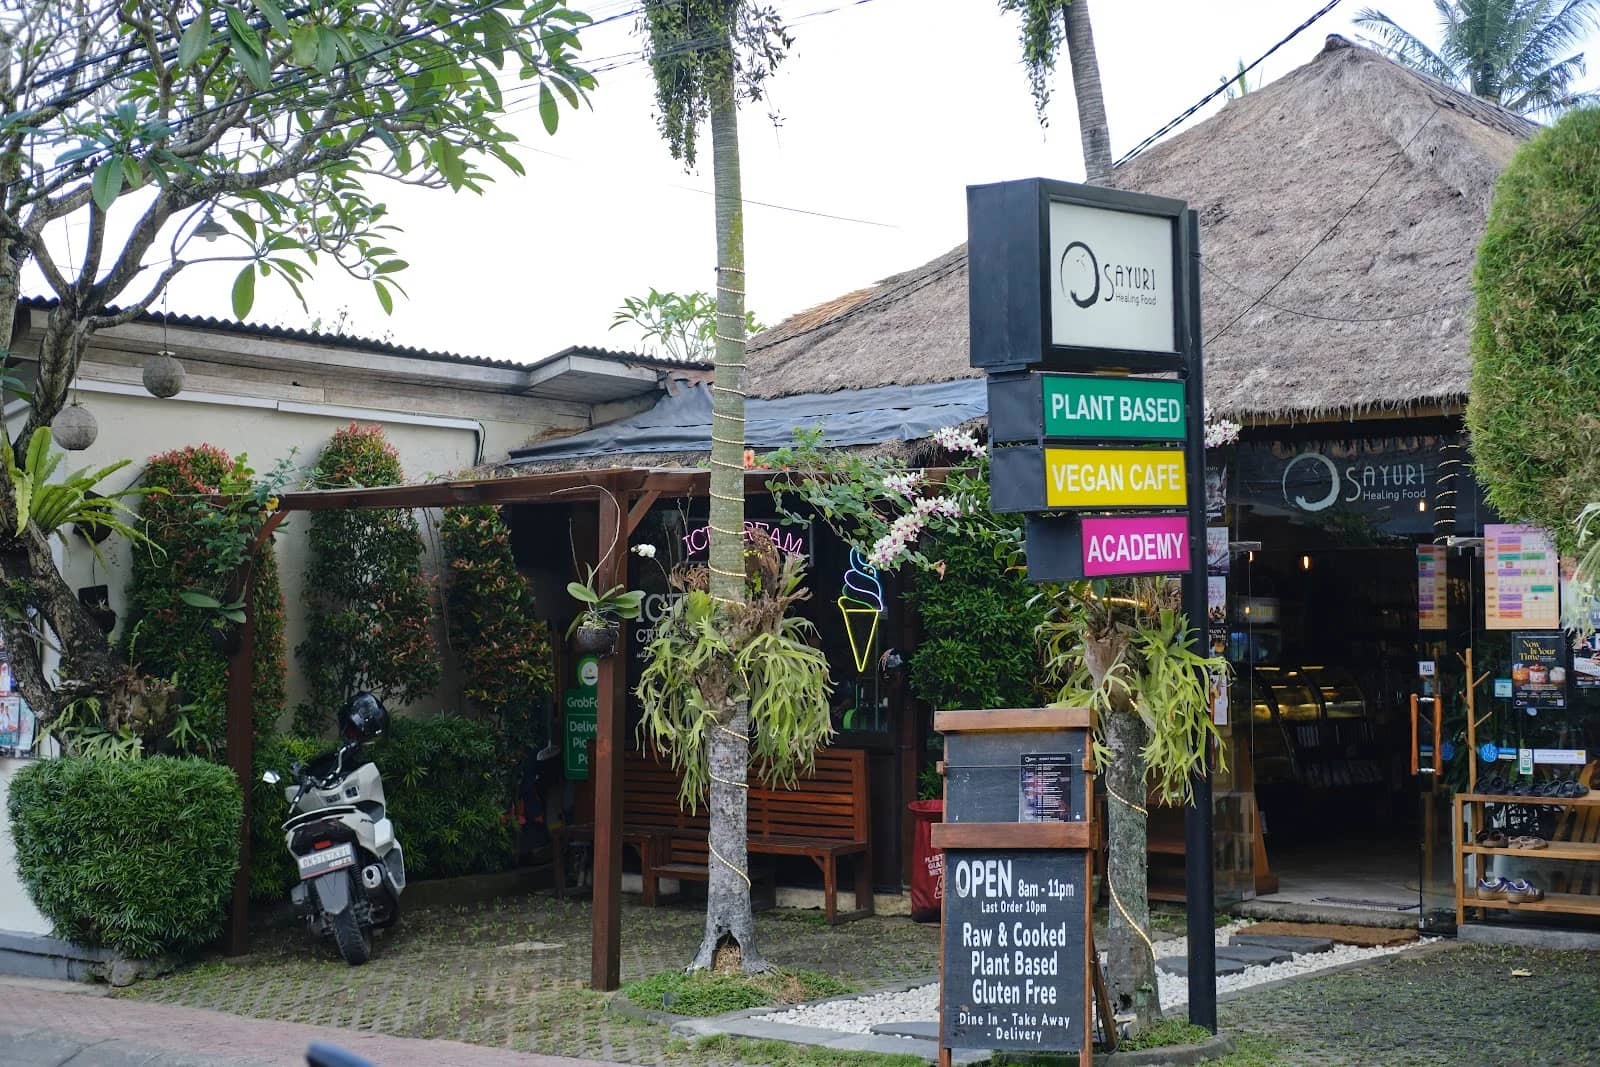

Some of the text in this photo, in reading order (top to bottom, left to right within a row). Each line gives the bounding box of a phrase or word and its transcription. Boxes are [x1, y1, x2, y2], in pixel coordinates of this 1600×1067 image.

[1104, 263, 1155, 301] SAYURI
[1116, 293, 1156, 306] Healing Food
[1052, 393, 1180, 423] PLANT BASED
[1052, 463, 1180, 492] VEGAN CAFE
[1346, 464, 1425, 502] SAYURI
[1363, 488, 1426, 502] Healing Food
[682, 526, 710, 555] IC
[1087, 532, 1184, 563] ACADEMY
[569, 721, 598, 732] Deliv
[573, 737, 589, 749] Pic
[955, 859, 1012, 898] OPEN
[1018, 878, 1038, 897] 8am
[1048, 878, 1074, 901] 11pm
[981, 900, 1047, 916] Last Order 10pm
[963, 921, 1066, 947] Raw & Cooked
[971, 950, 1058, 975] Plant Based
[972, 979, 1057, 1004] Gluten Free
[959, 1012, 984, 1025] Dine
[988, 1012, 998, 1025] In
[1012, 1012, 1037, 1025] Take
[1041, 1012, 1070, 1029] Away
[996, 1027, 1042, 1043] Delivery
